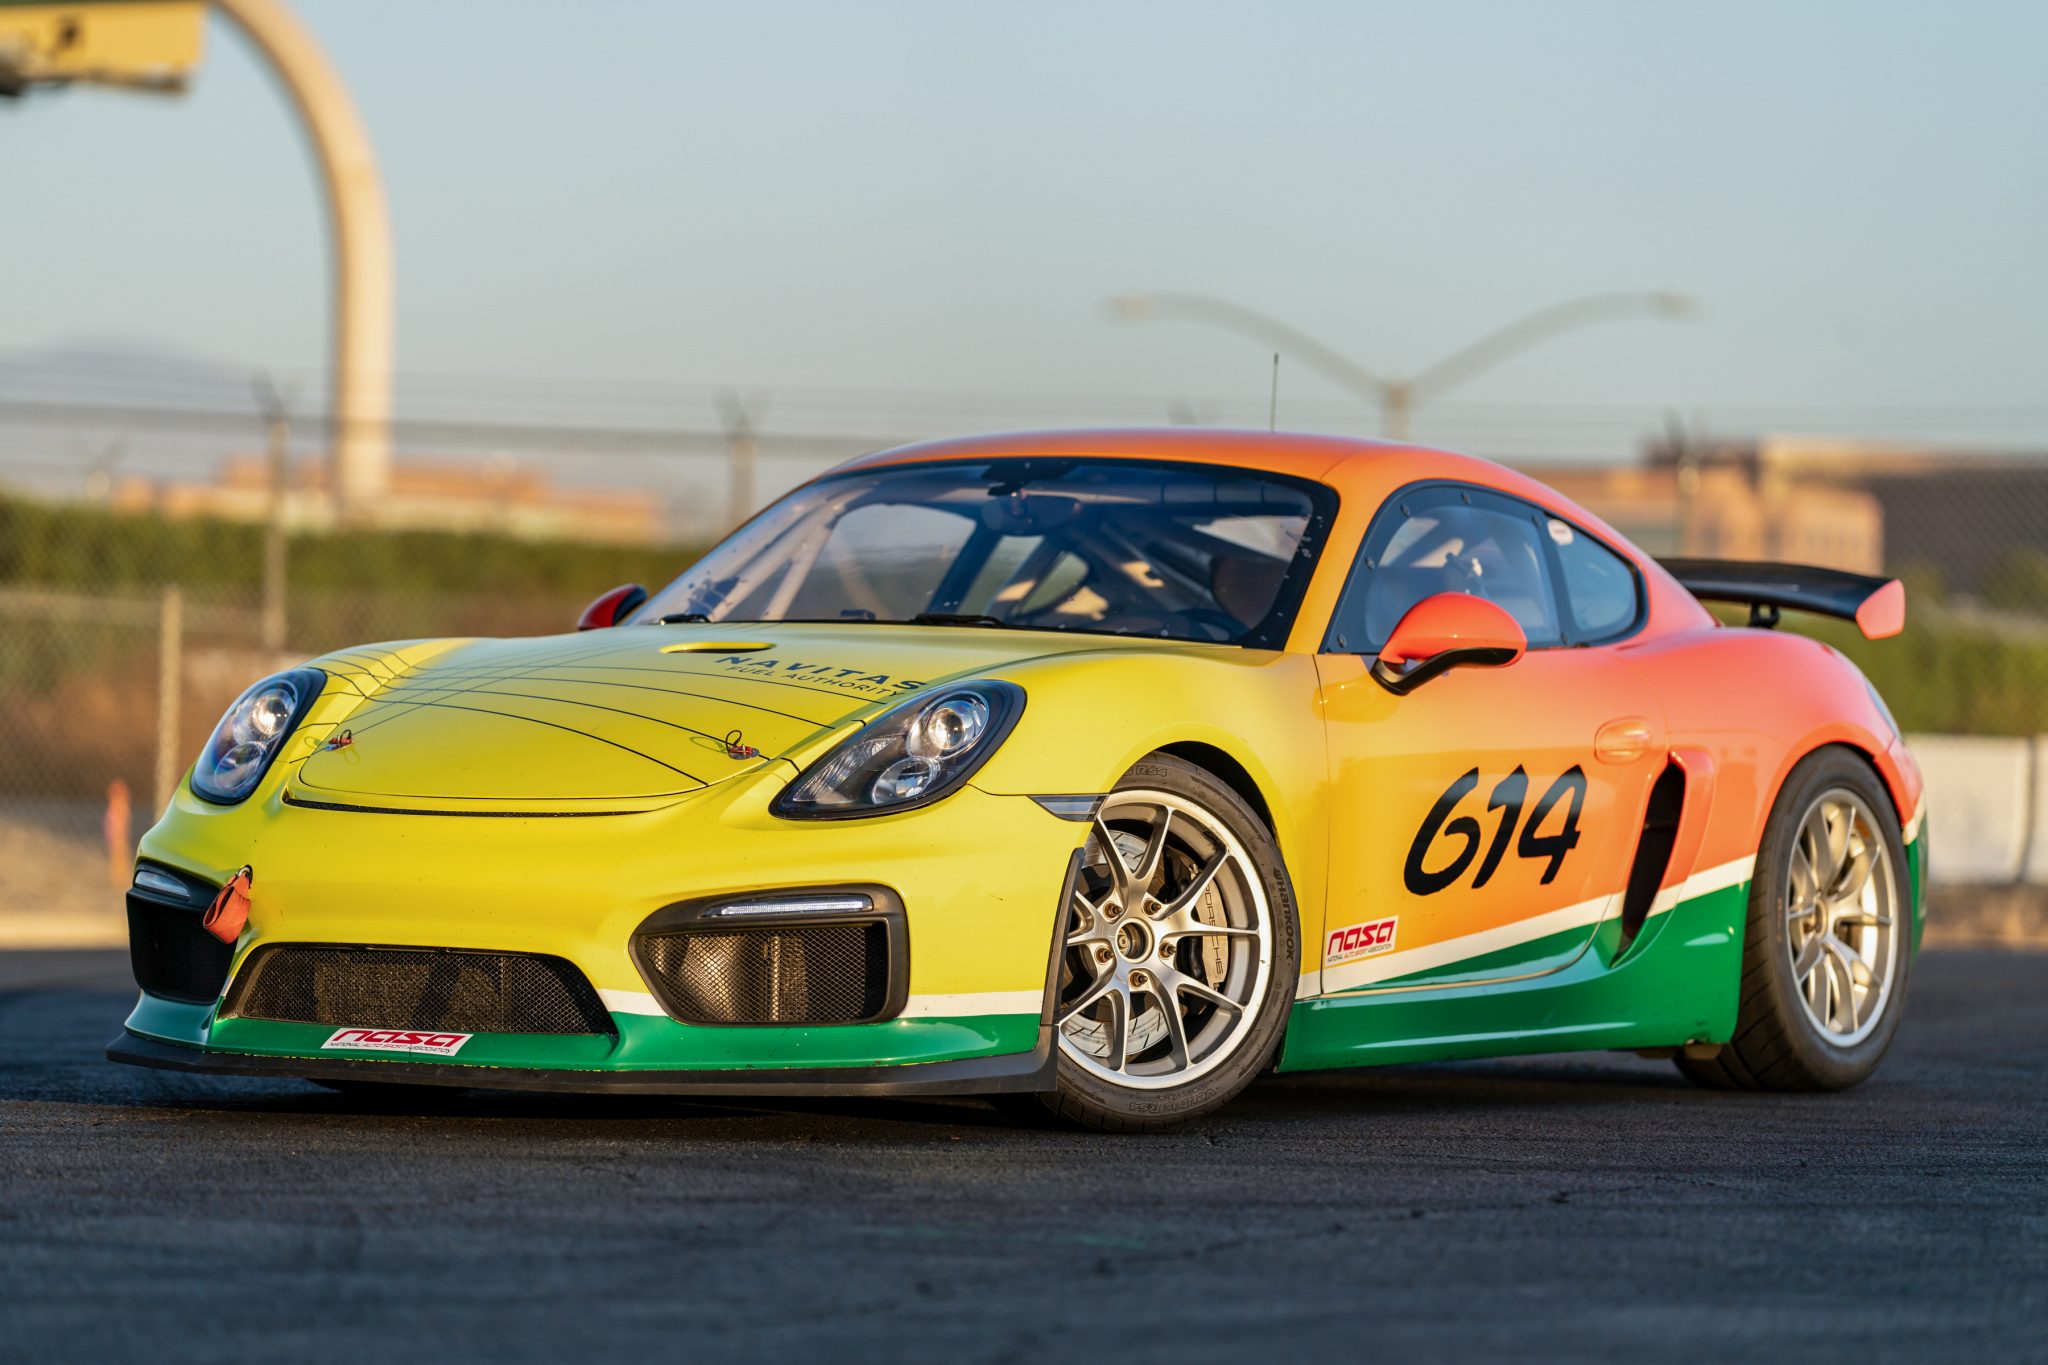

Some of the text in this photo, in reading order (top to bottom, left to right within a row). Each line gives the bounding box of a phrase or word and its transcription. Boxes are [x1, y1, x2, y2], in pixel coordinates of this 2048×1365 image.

[716, 656, 927, 690] NAVITAS
[726, 666, 909, 697] FUEL AUTHORITY
[1403, 764, 1588, 896] 614
